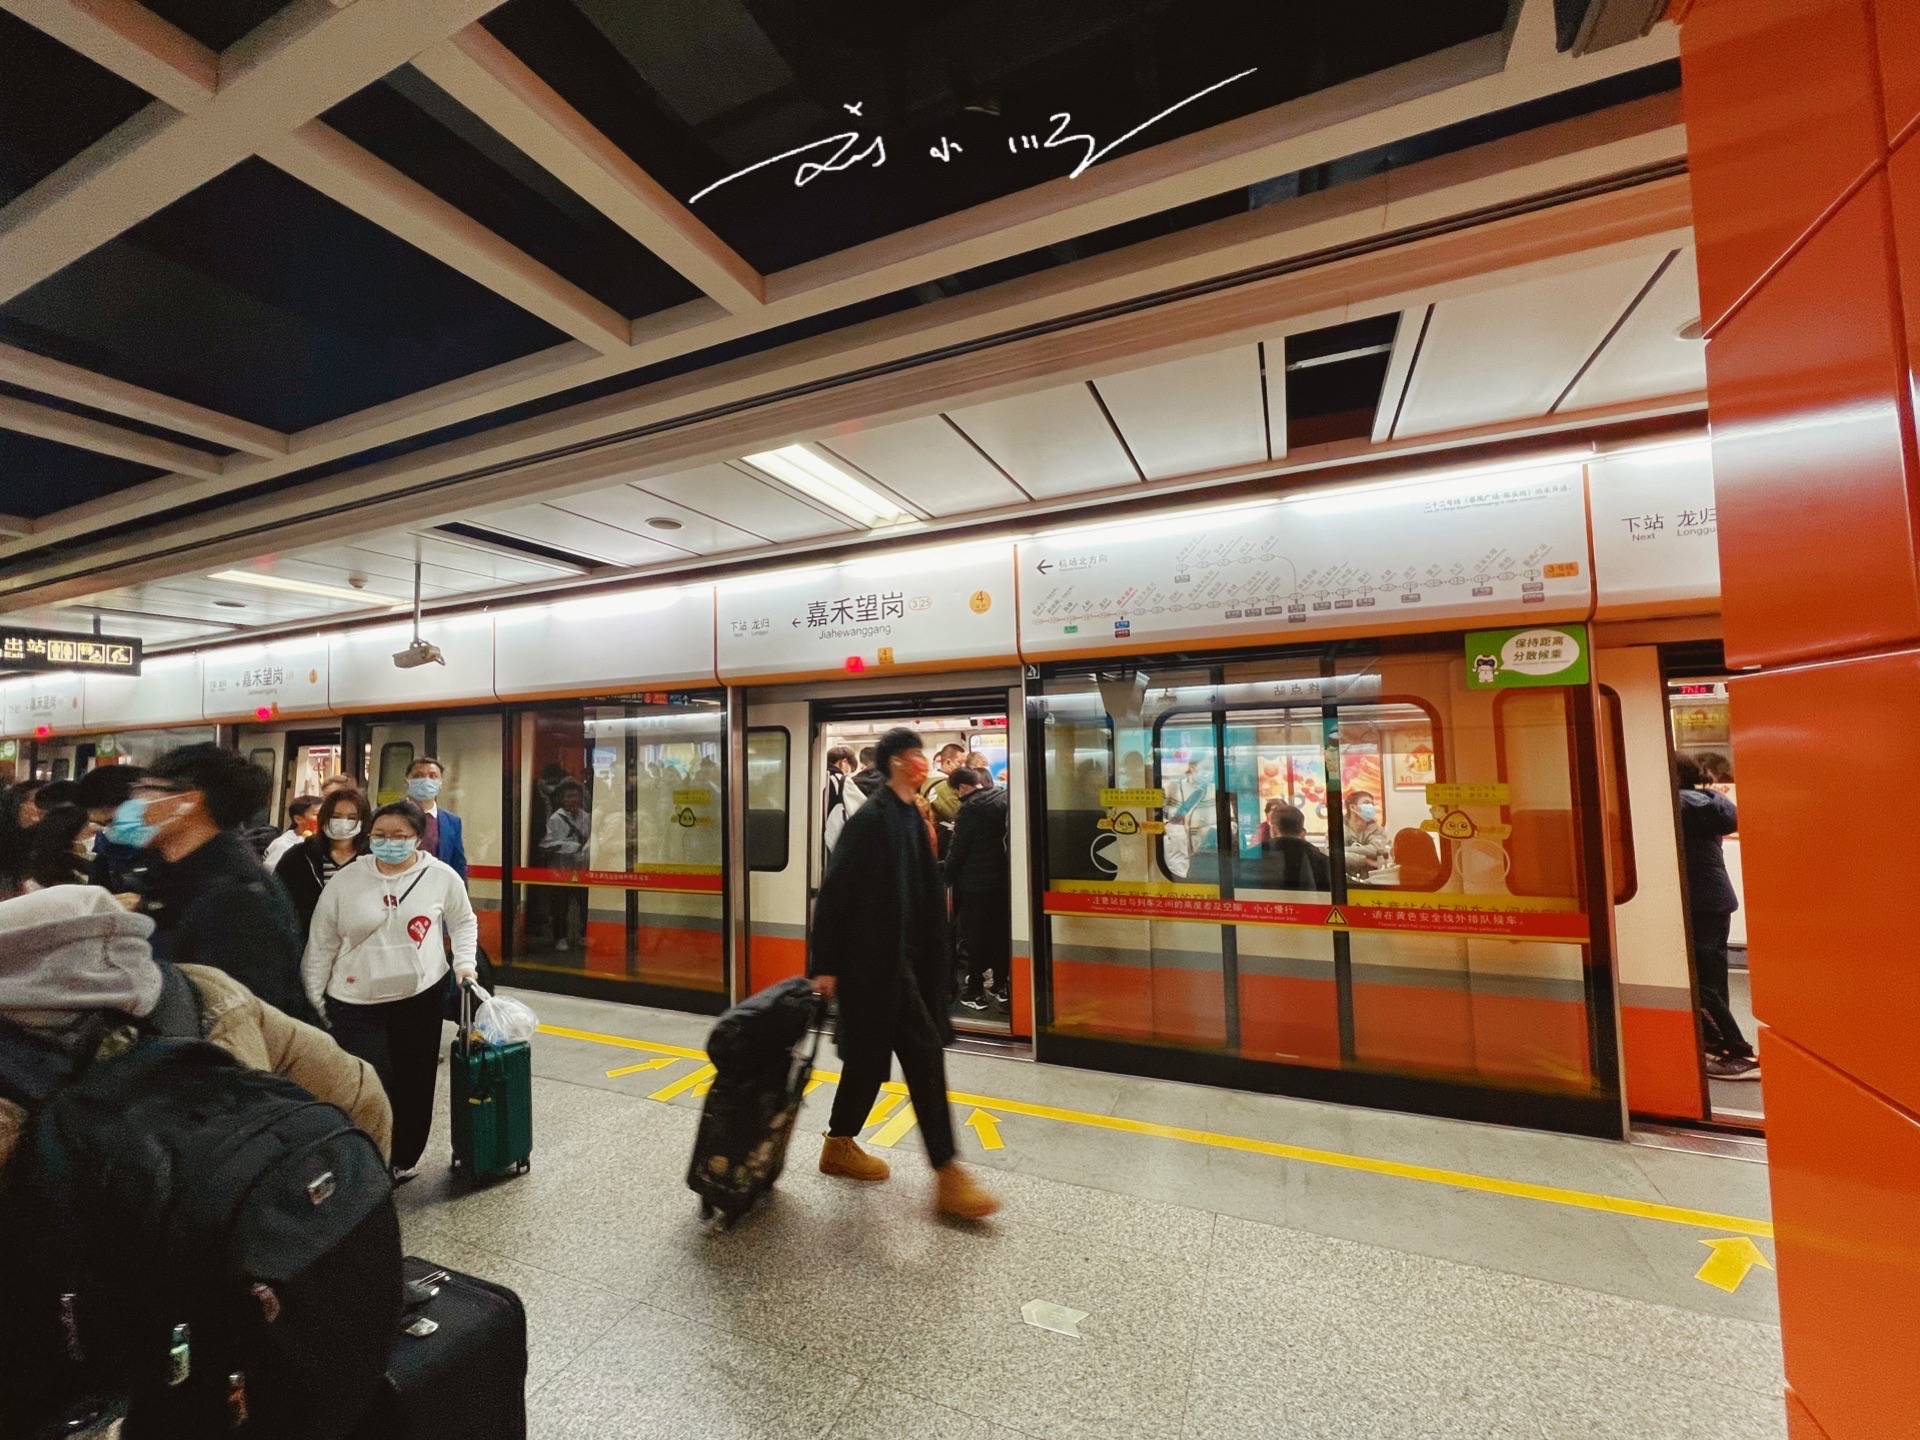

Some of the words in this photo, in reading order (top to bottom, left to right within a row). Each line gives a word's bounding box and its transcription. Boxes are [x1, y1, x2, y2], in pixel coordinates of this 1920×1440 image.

[1621, 513, 1664, 532] 下站
[1677, 507, 1716, 527] 龙归
[1632, 533, 1655, 541] Next
[806, 591, 904, 628] 嘉禾望岗
[819, 624, 892, 640] Jiahewanggang
[4, 637, 46, 654] 出站
[1515, 636, 1564, 648] 保持距离
[242, 666, 283, 688] 嘉禾望岗
